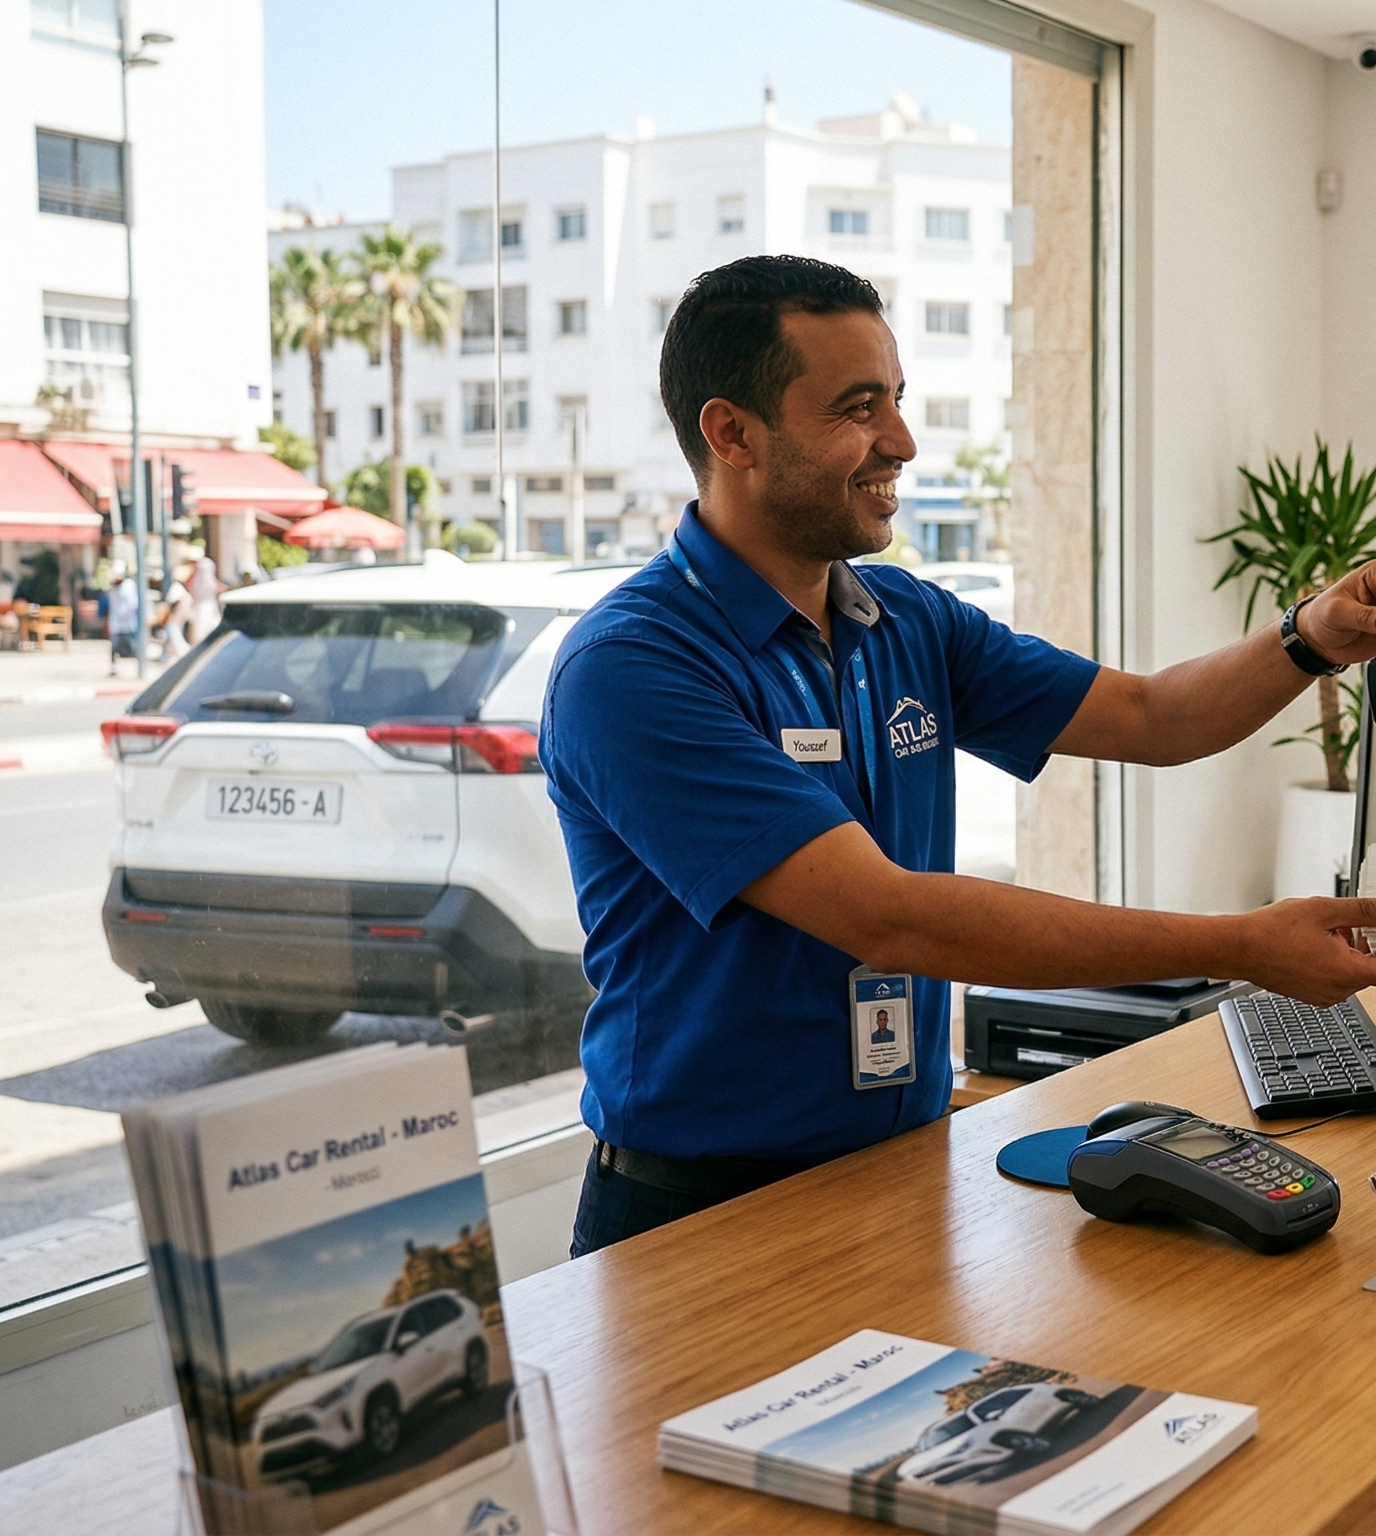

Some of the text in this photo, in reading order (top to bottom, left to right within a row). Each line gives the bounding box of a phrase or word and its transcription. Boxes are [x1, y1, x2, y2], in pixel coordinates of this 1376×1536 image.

[889, 713, 938, 749] ATLAS
[218, 785, 296, 816] 123456
[312, 789, 327, 818] A
[229, 1161, 280, 1193] Atlas
[286, 1148, 319, 1173] Car
[324, 1126, 386, 1162] Rental
[402, 1110, 460, 1139] Maroc
